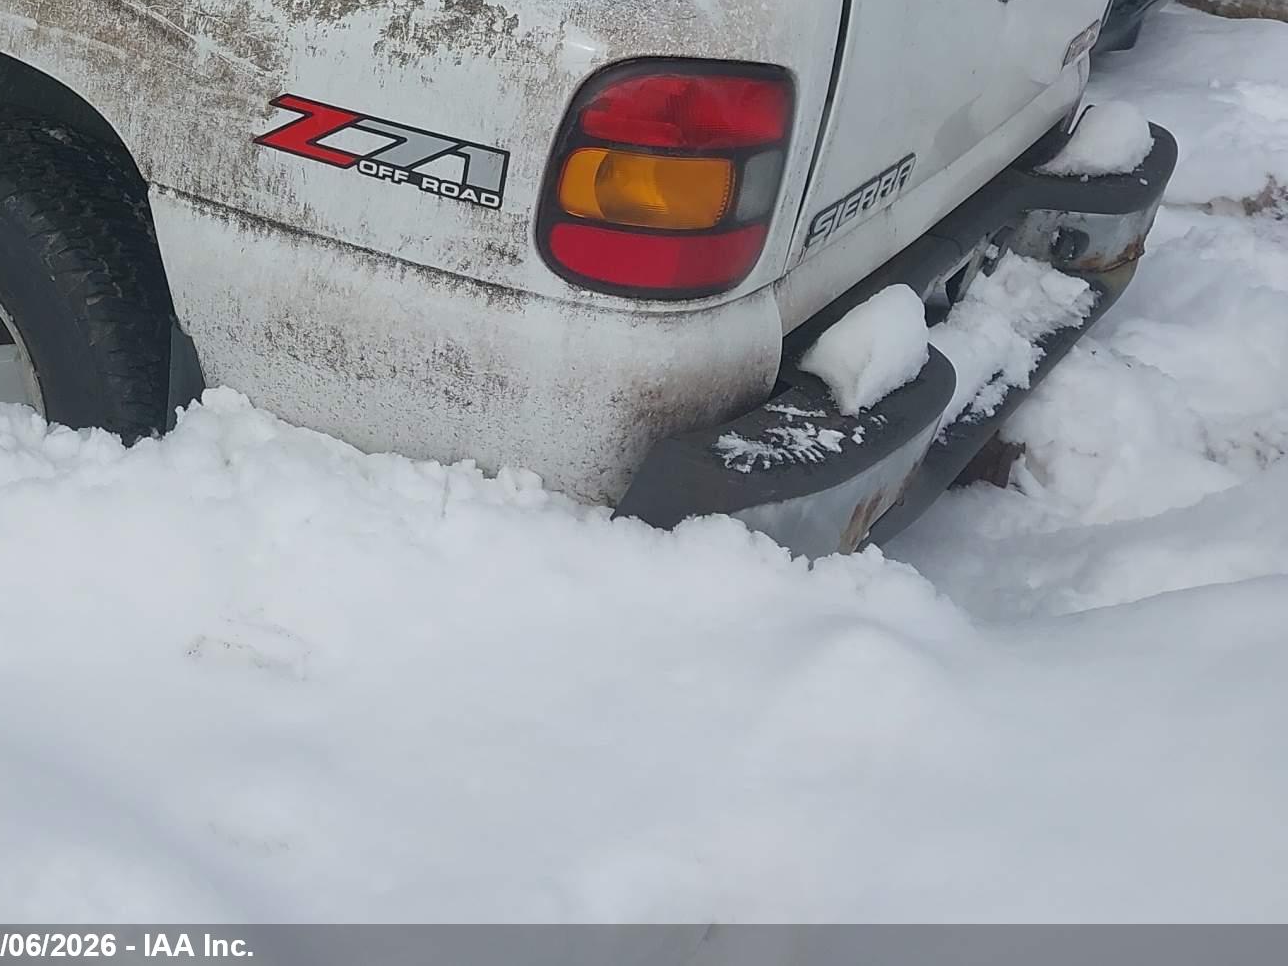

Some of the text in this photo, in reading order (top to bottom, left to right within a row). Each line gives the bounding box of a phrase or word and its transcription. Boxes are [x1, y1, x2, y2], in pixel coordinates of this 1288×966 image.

[252, 93, 511, 195] Z71
[357, 159, 503, 210] OFF ROAD
[808, 152, 917, 247] SIERRA
